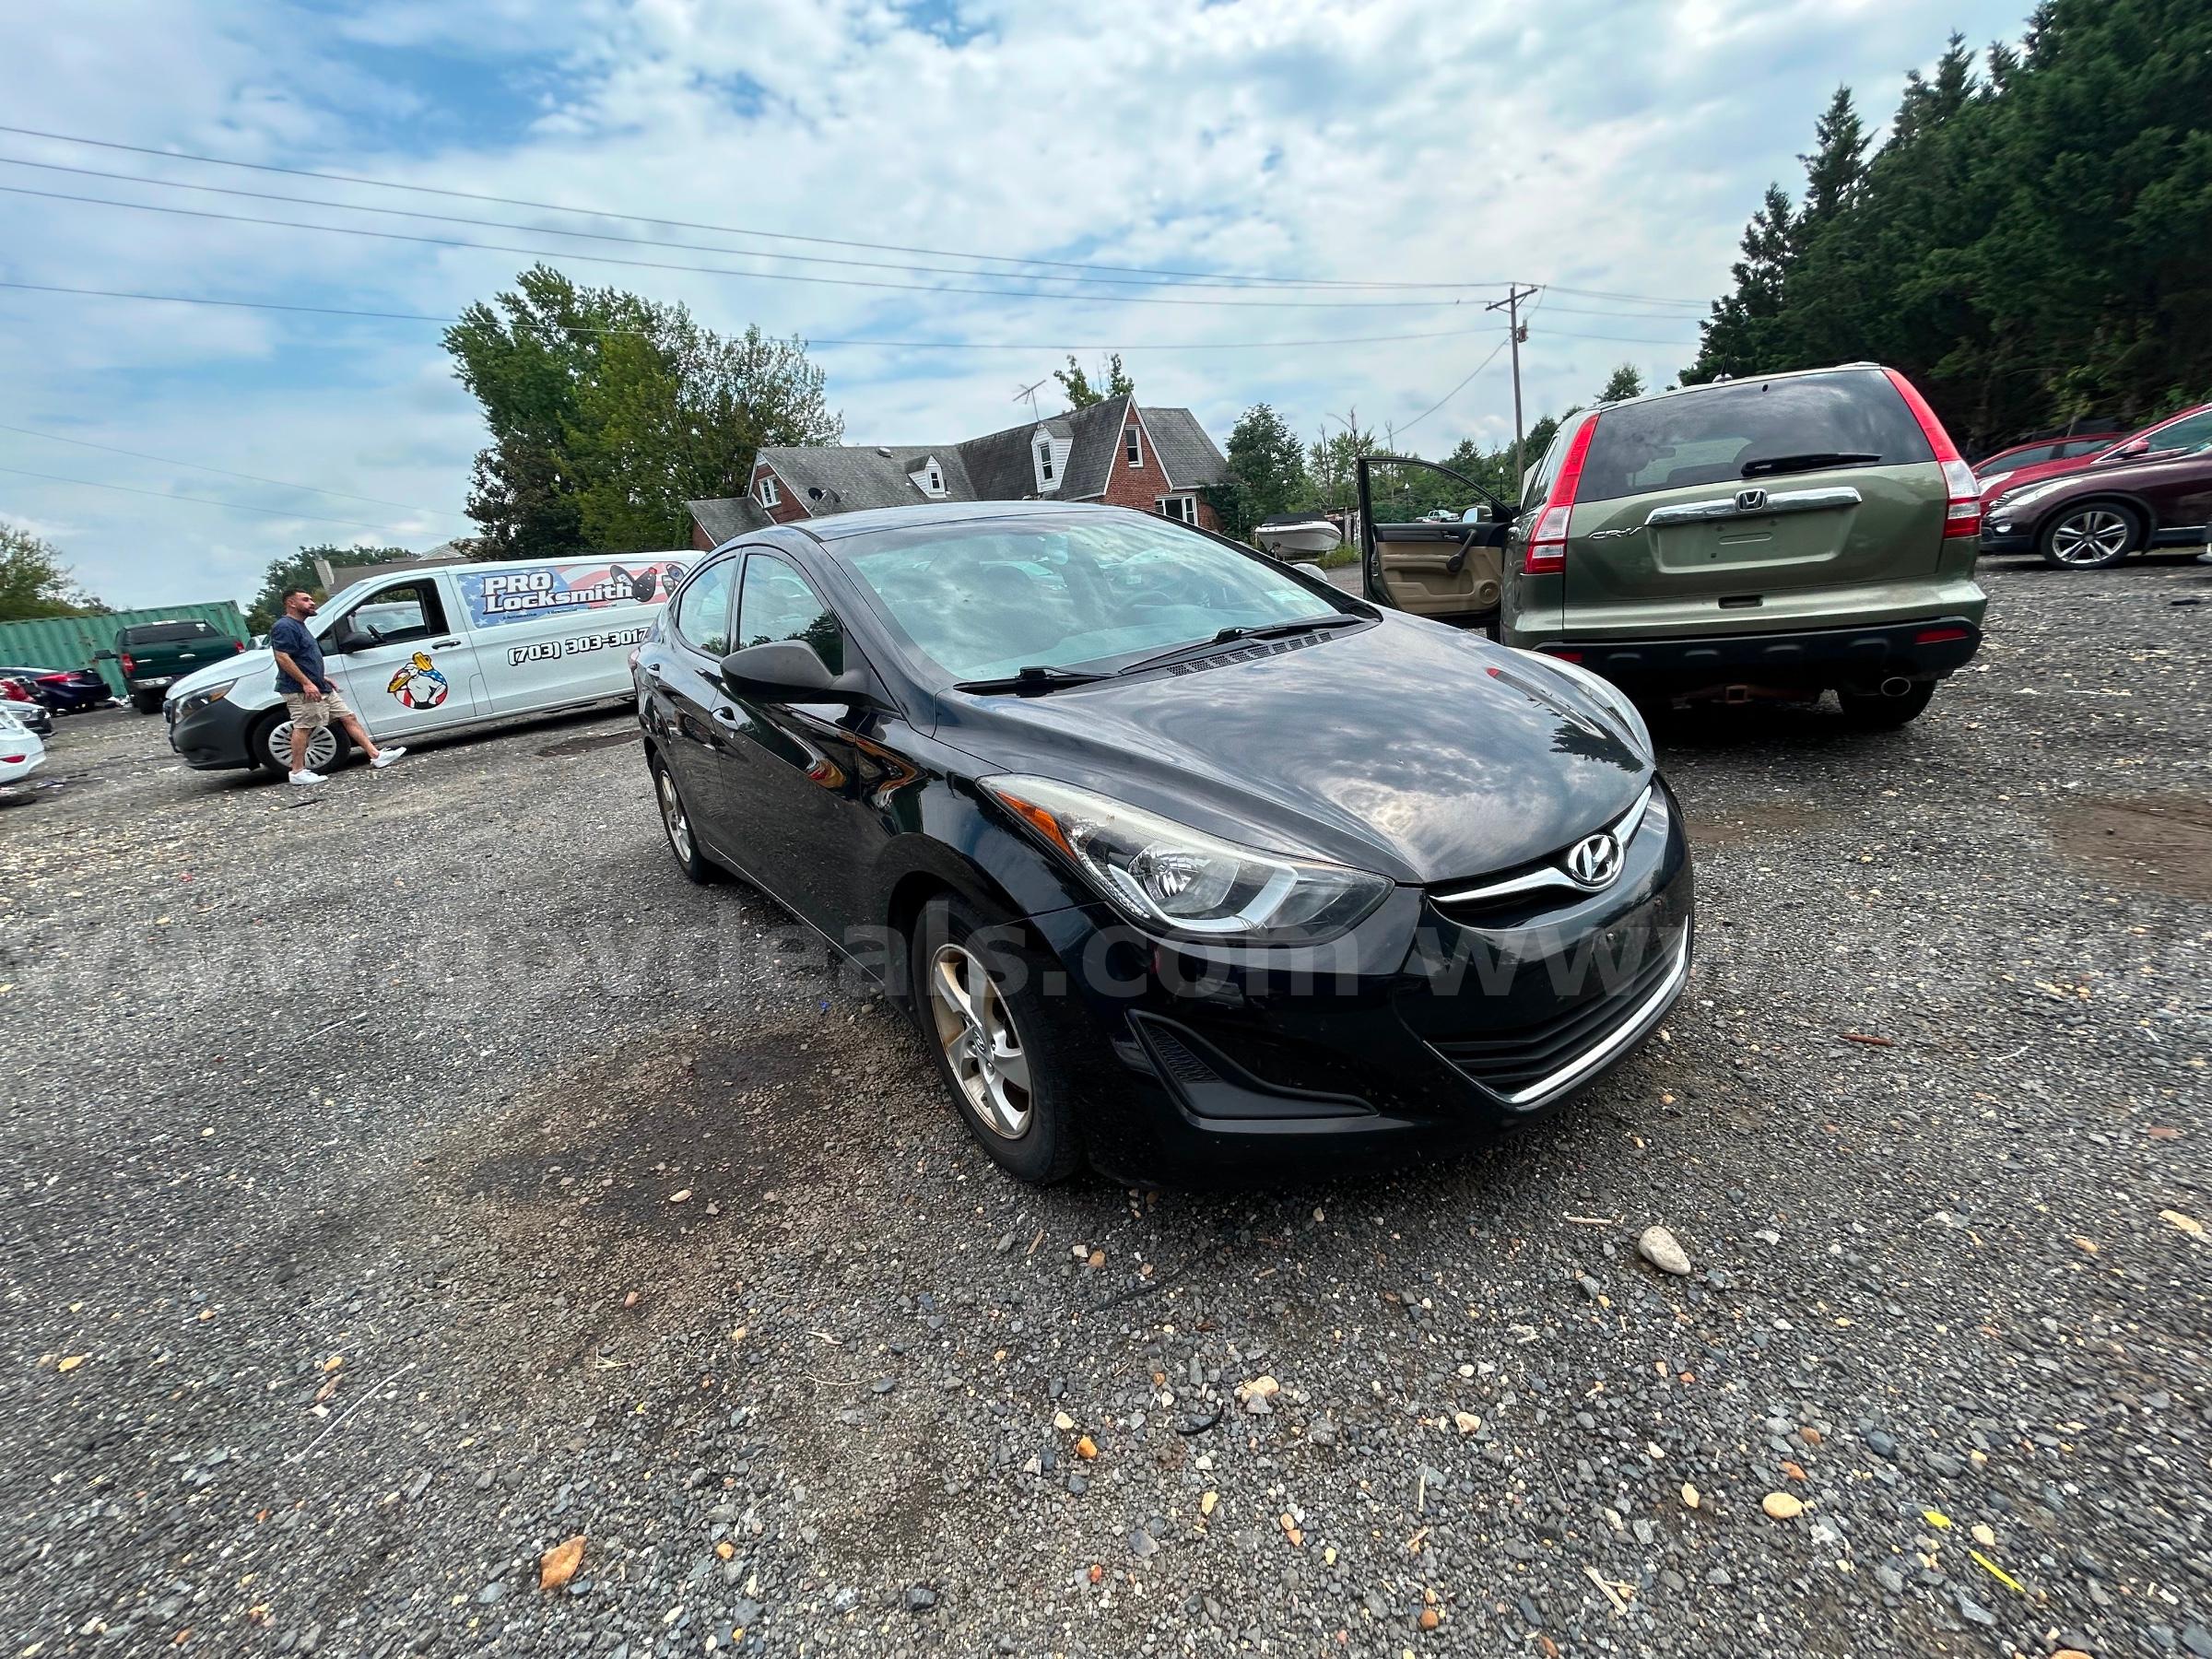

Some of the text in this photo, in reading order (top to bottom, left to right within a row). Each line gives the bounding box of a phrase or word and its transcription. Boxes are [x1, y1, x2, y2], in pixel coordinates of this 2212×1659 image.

[1589, 526, 1643, 539] CR-V
[482, 571, 553, 597] PRO
[483, 582, 634, 615] Locksmith
[508, 627, 651, 665] (703) 303-3017
